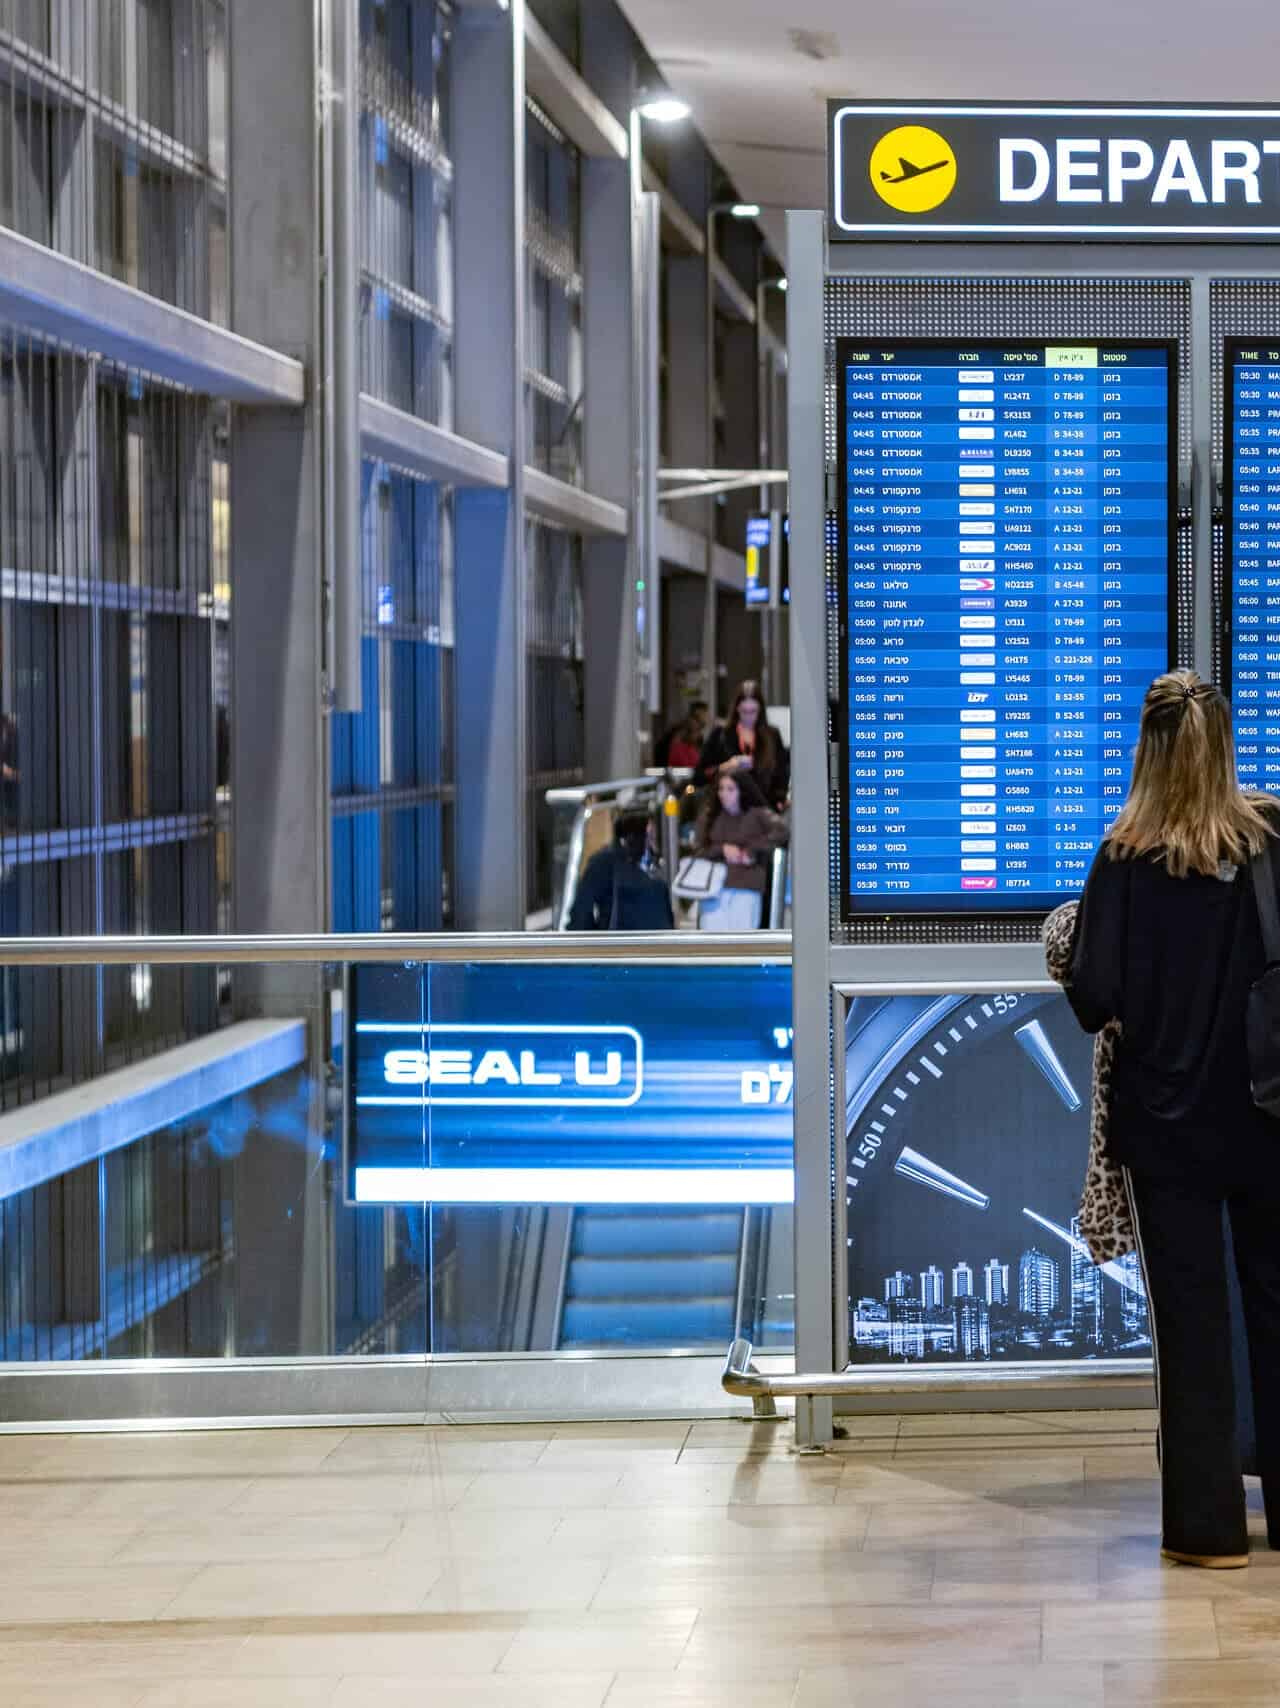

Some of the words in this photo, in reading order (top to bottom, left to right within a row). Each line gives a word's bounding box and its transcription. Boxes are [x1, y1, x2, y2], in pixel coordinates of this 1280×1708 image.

[1240, 351, 1259, 360] TIME
[1268, 351, 1280, 360] TO
[383, 1049, 562, 1085] SEAL
[574, 1050, 622, 1086] U
[858, 1132, 883, 1160] 50
